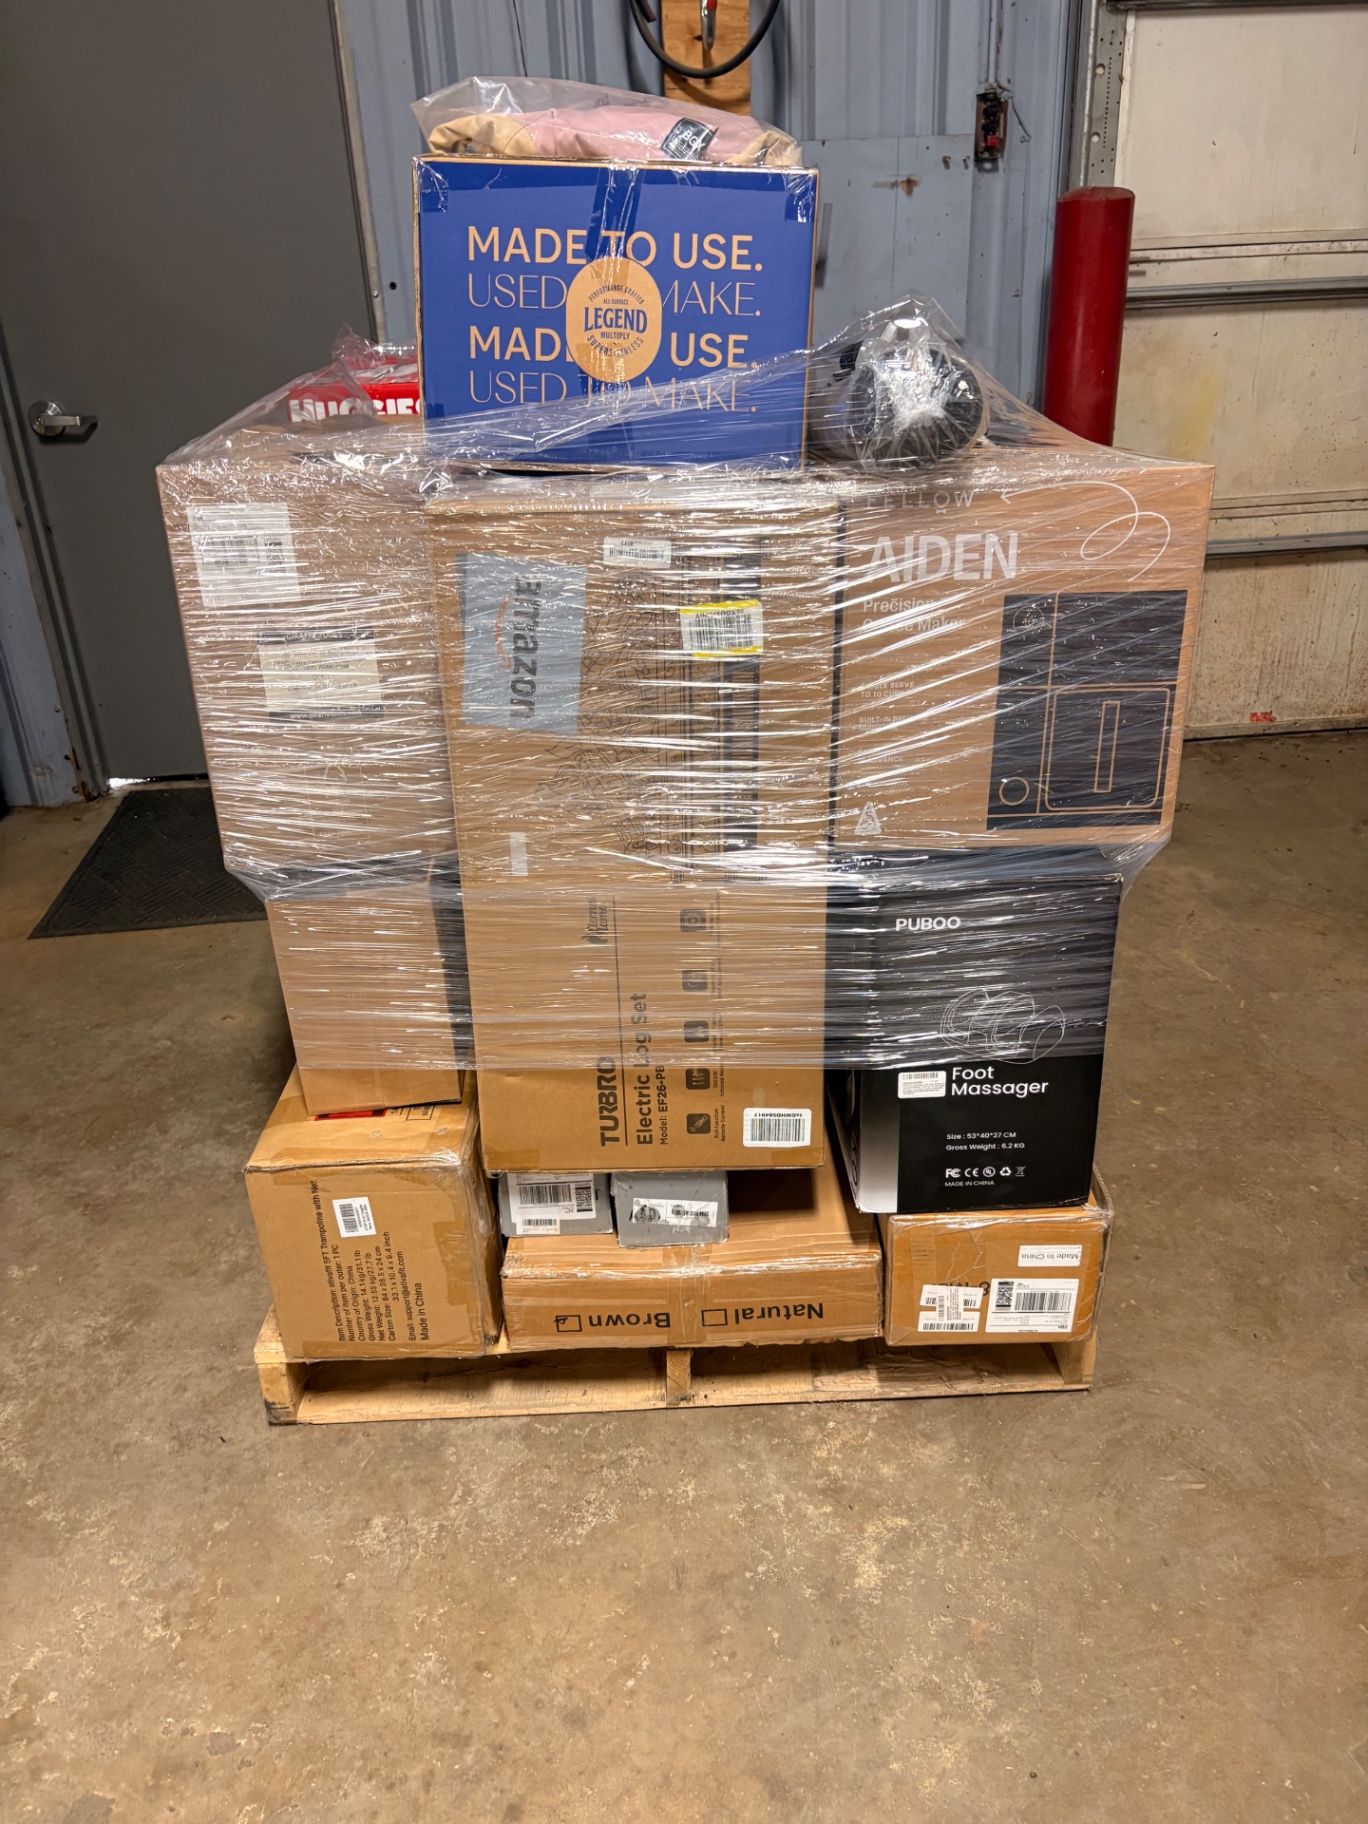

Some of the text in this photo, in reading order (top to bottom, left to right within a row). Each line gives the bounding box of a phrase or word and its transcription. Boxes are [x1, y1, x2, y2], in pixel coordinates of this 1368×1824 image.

[468, 226, 763, 271] MADE TO USE.
[468, 273, 567, 310] USED
[625, 287, 645, 305] CRAFTED
[584, 307, 647, 333] LEGEND
[600, 331, 630, 340] MULTIPLY
[470, 325, 758, 369] MAD USE.
[470, 370, 567, 405] USED
[645, 378, 756, 413] MAKE.
[866, 491, 974, 509] FELLOW
[867, 533, 1018, 582] AIDEN
[896, 916, 961, 932] PUBOO
[630, 993, 653, 1145] Electric Log Set
[952, 1066, 994, 1082] Foot
[951, 1080, 1048, 1098] Massager
[596, 1056, 620, 1146] TURBRO
[658, 1115, 668, 1145] Model:
[970, 1143, 996, 1151] Weight
[310, 1180, 318, 1193] Net
[312, 1195, 321, 1210] with
[316, 1212, 328, 1249] Trampoline
[383, 1232, 391, 1247] inch
[322, 1251, 331, 1264] 5FT
[331, 1244, 338, 1254] PC
[375, 1246, 381, 1256] cm
[385, 1248, 393, 1259] 9.4
[336, 1260, 344, 1280] outer:
[376, 1257, 383, 1266] 24
[347, 1266, 355, 1284] China
[388, 1266, 396, 1280] 10.4
[339, 1281, 348, 1292] per
[370, 1286, 379, 1303] 12.55
[390, 1287, 399, 1301] 33.1
[414, 1283, 424, 1307] China
[341, 1293, 349, 1307] Item
[350, 1286, 359, 1307] Origin:
[330, 1289, 342, 1326] Description:
[362, 1298, 372, 1322] Weight:
[374, 1304, 383, 1328] Weight:
[384, 1302, 392, 1318] Size:
[588, 1302, 824, 1328] Natural Brown
[346, 1317, 355, 1341] Number
[356, 1316, 366, 1341] Country
[367, 1323, 375, 1341] Gross
[378, 1330, 386, 1341] Net
[387, 1320, 396, 1341] Carton
[407, 1322, 416, 1340] Email:
[419, 1318, 429, 1340] Made
